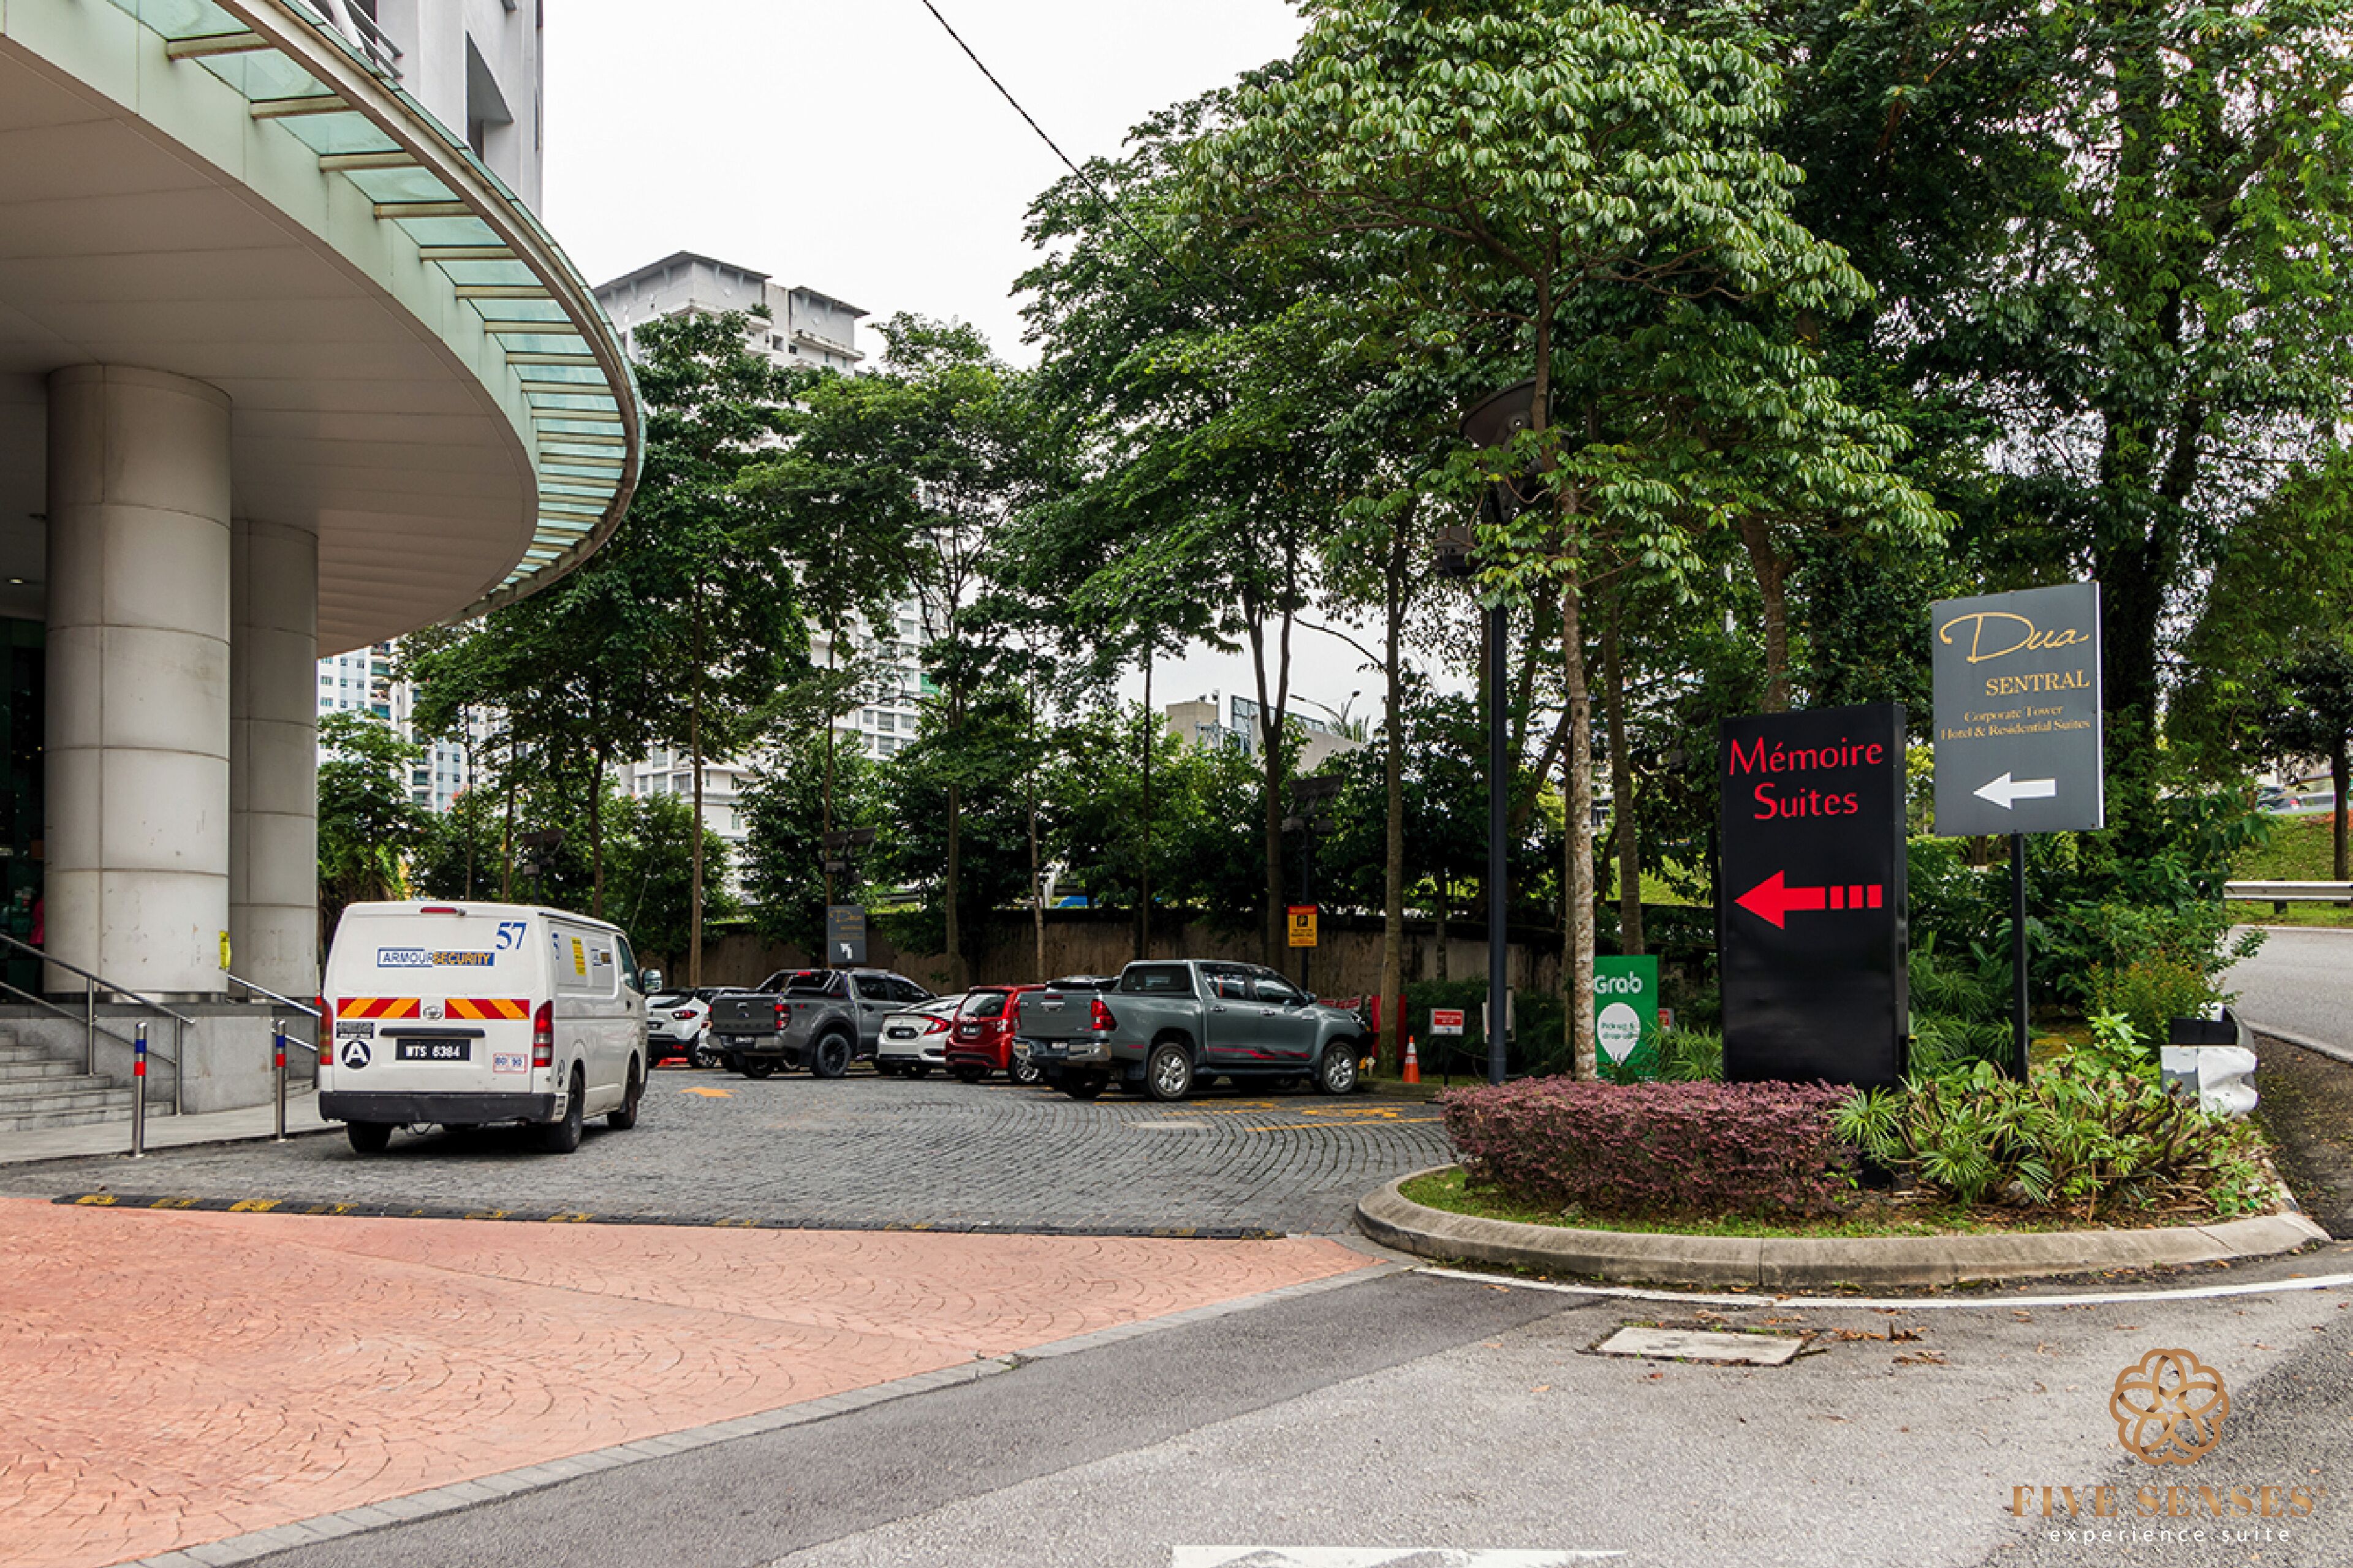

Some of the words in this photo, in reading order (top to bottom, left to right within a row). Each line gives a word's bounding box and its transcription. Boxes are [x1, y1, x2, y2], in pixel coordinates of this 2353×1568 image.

[1939, 612, 2089, 664] Dua
[1985, 669, 2090, 697] SENTRAL
[1965, 710, 2021, 724] Corporate
[2023, 705, 2064, 718] Tower
[1941, 726, 1972, 740] Hotel
[1974, 726, 1985, 738] &
[1988, 721, 2052, 737] Residential
[2054, 719, 2090, 732] Suites
[1729, 736, 1883, 775] Mémoire
[1754, 781, 1859, 819] Suites
[496, 920, 527, 950] 57
[1593, 971, 1643, 994] Grab
[344, 1040, 368, 1064] A
